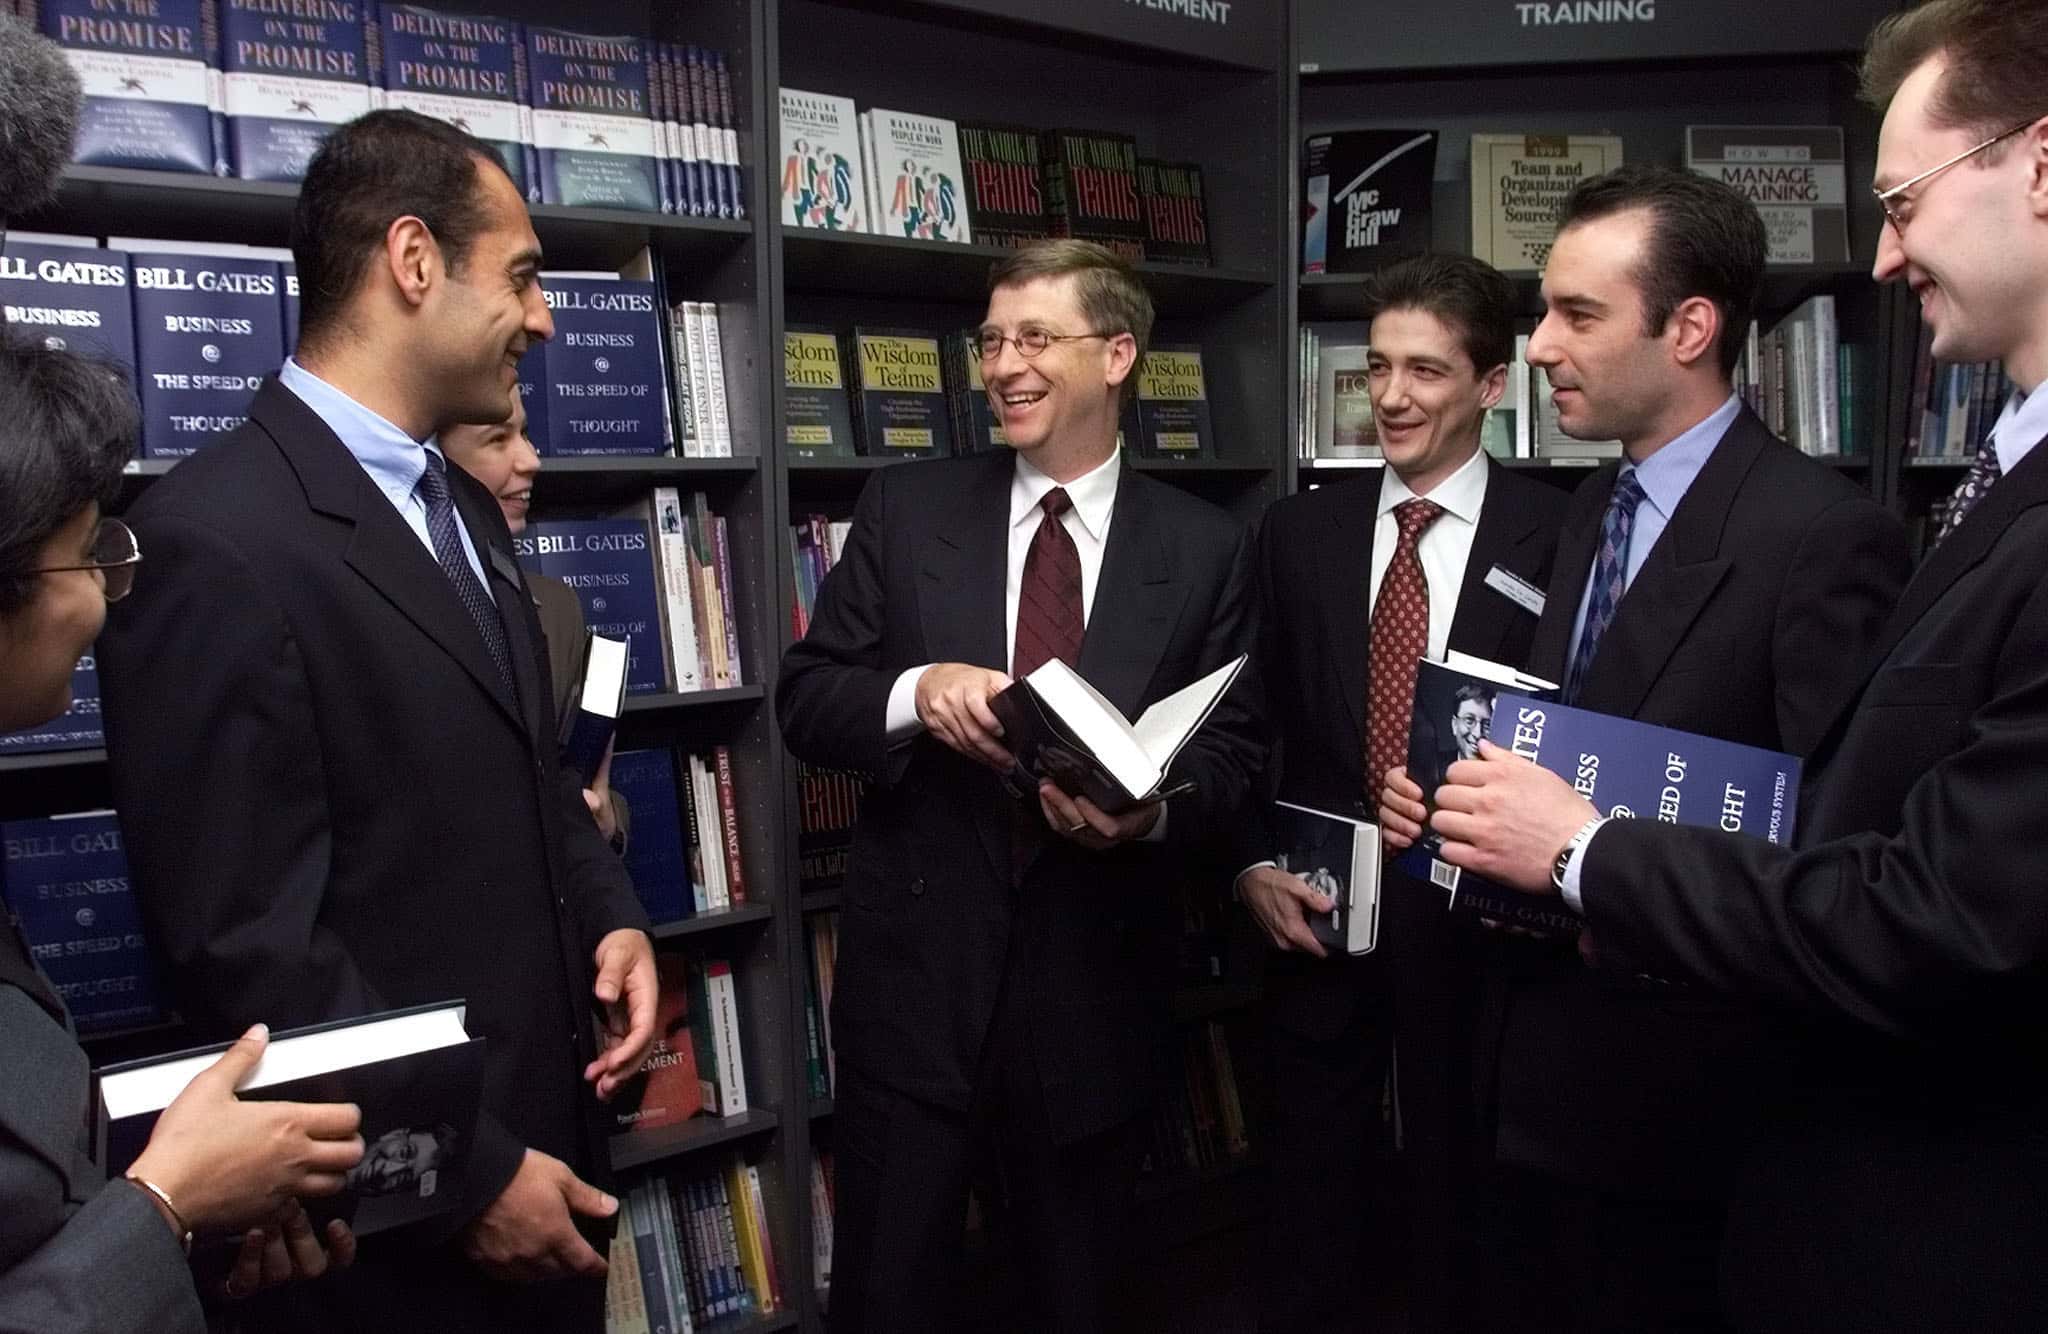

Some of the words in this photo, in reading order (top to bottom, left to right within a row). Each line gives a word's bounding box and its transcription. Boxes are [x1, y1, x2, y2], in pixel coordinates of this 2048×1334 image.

[1515, 0, 1656, 25] TRAINING
[60, 14, 193, 53] PROMISE
[264, 21, 287, 39] ON
[293, 23, 326, 42] THE
[391, 12, 506, 44] DELIVERING
[237, 39, 357, 77] PROMISE
[423, 41, 446, 60] ON
[448, 45, 480, 63] THE
[535, 35, 640, 62] DELIVERING
[400, 61, 508, 95] PROMISE
[564, 63, 584, 77] ON
[589, 65, 617, 82] THE
[542, 80, 642, 112] PROMISE
[781, 96, 837, 113] MANAGING
[782, 107, 807, 121] PEOPLE
[809, 110, 818, 121] AT
[819, 111, 839, 125] WORK
[889, 118, 941, 136] MANAGING
[890, 129, 915, 143] PEOPLE
[916, 131, 924, 143] AT
[925, 133, 943, 146] WORK
[1511, 159, 1551, 176] Team
[1555, 160, 1583, 176] and
[1721, 167, 1817, 184] MANAGE
[1349, 189, 1379, 213] Mc
[1347, 208, 1400, 229] Graw
[1345, 226, 1380, 249] Hill
[38, 259, 126, 288] GATES
[135, 266, 195, 291] BILL
[196, 271, 276, 296] GATES
[542, 290, 588, 310] BILL
[590, 293, 653, 312] GATES
[4, 305, 101, 328] BUSINESS
[164, 315, 253, 335] BUSINESS
[565, 332, 635, 348] BUSINESS
[201, 343, 222, 363] @
[863, 342, 938, 366] Wisdom
[594, 356, 610, 373] @
[153, 373, 190, 390] THE
[192, 374, 245, 391] SPEED
[875, 367, 936, 388] Teams
[1148, 378, 1199, 396] Teams
[556, 383, 585, 397] THE
[587, 383, 629, 397] SPEED
[630, 384, 650, 397] OF
[695, 368, 708, 425] LEARNER
[711, 368, 725, 425] LEARNER
[569, 419, 641, 434] THOUGHT
[537, 535, 583, 554] BILL
[585, 533, 646, 551] GATES
[562, 573, 630, 588] BUSINESS
[592, 597, 607, 612] @
[629, 621, 647, 633] OF
[1511, 707, 1546, 767] TES
[1665, 752, 1687, 783] OF
[1775, 771, 1788, 807] SYSTEM
[717, 751, 730, 787] TRUST
[724, 807, 738, 857] BALANCE
[4, 837, 66, 860] BILL
[71, 831, 122, 854] GAT
[36, 877, 130, 900] BUSINESS
[31, 943, 63, 959] THE
[65, 936, 121, 956] SPEED
